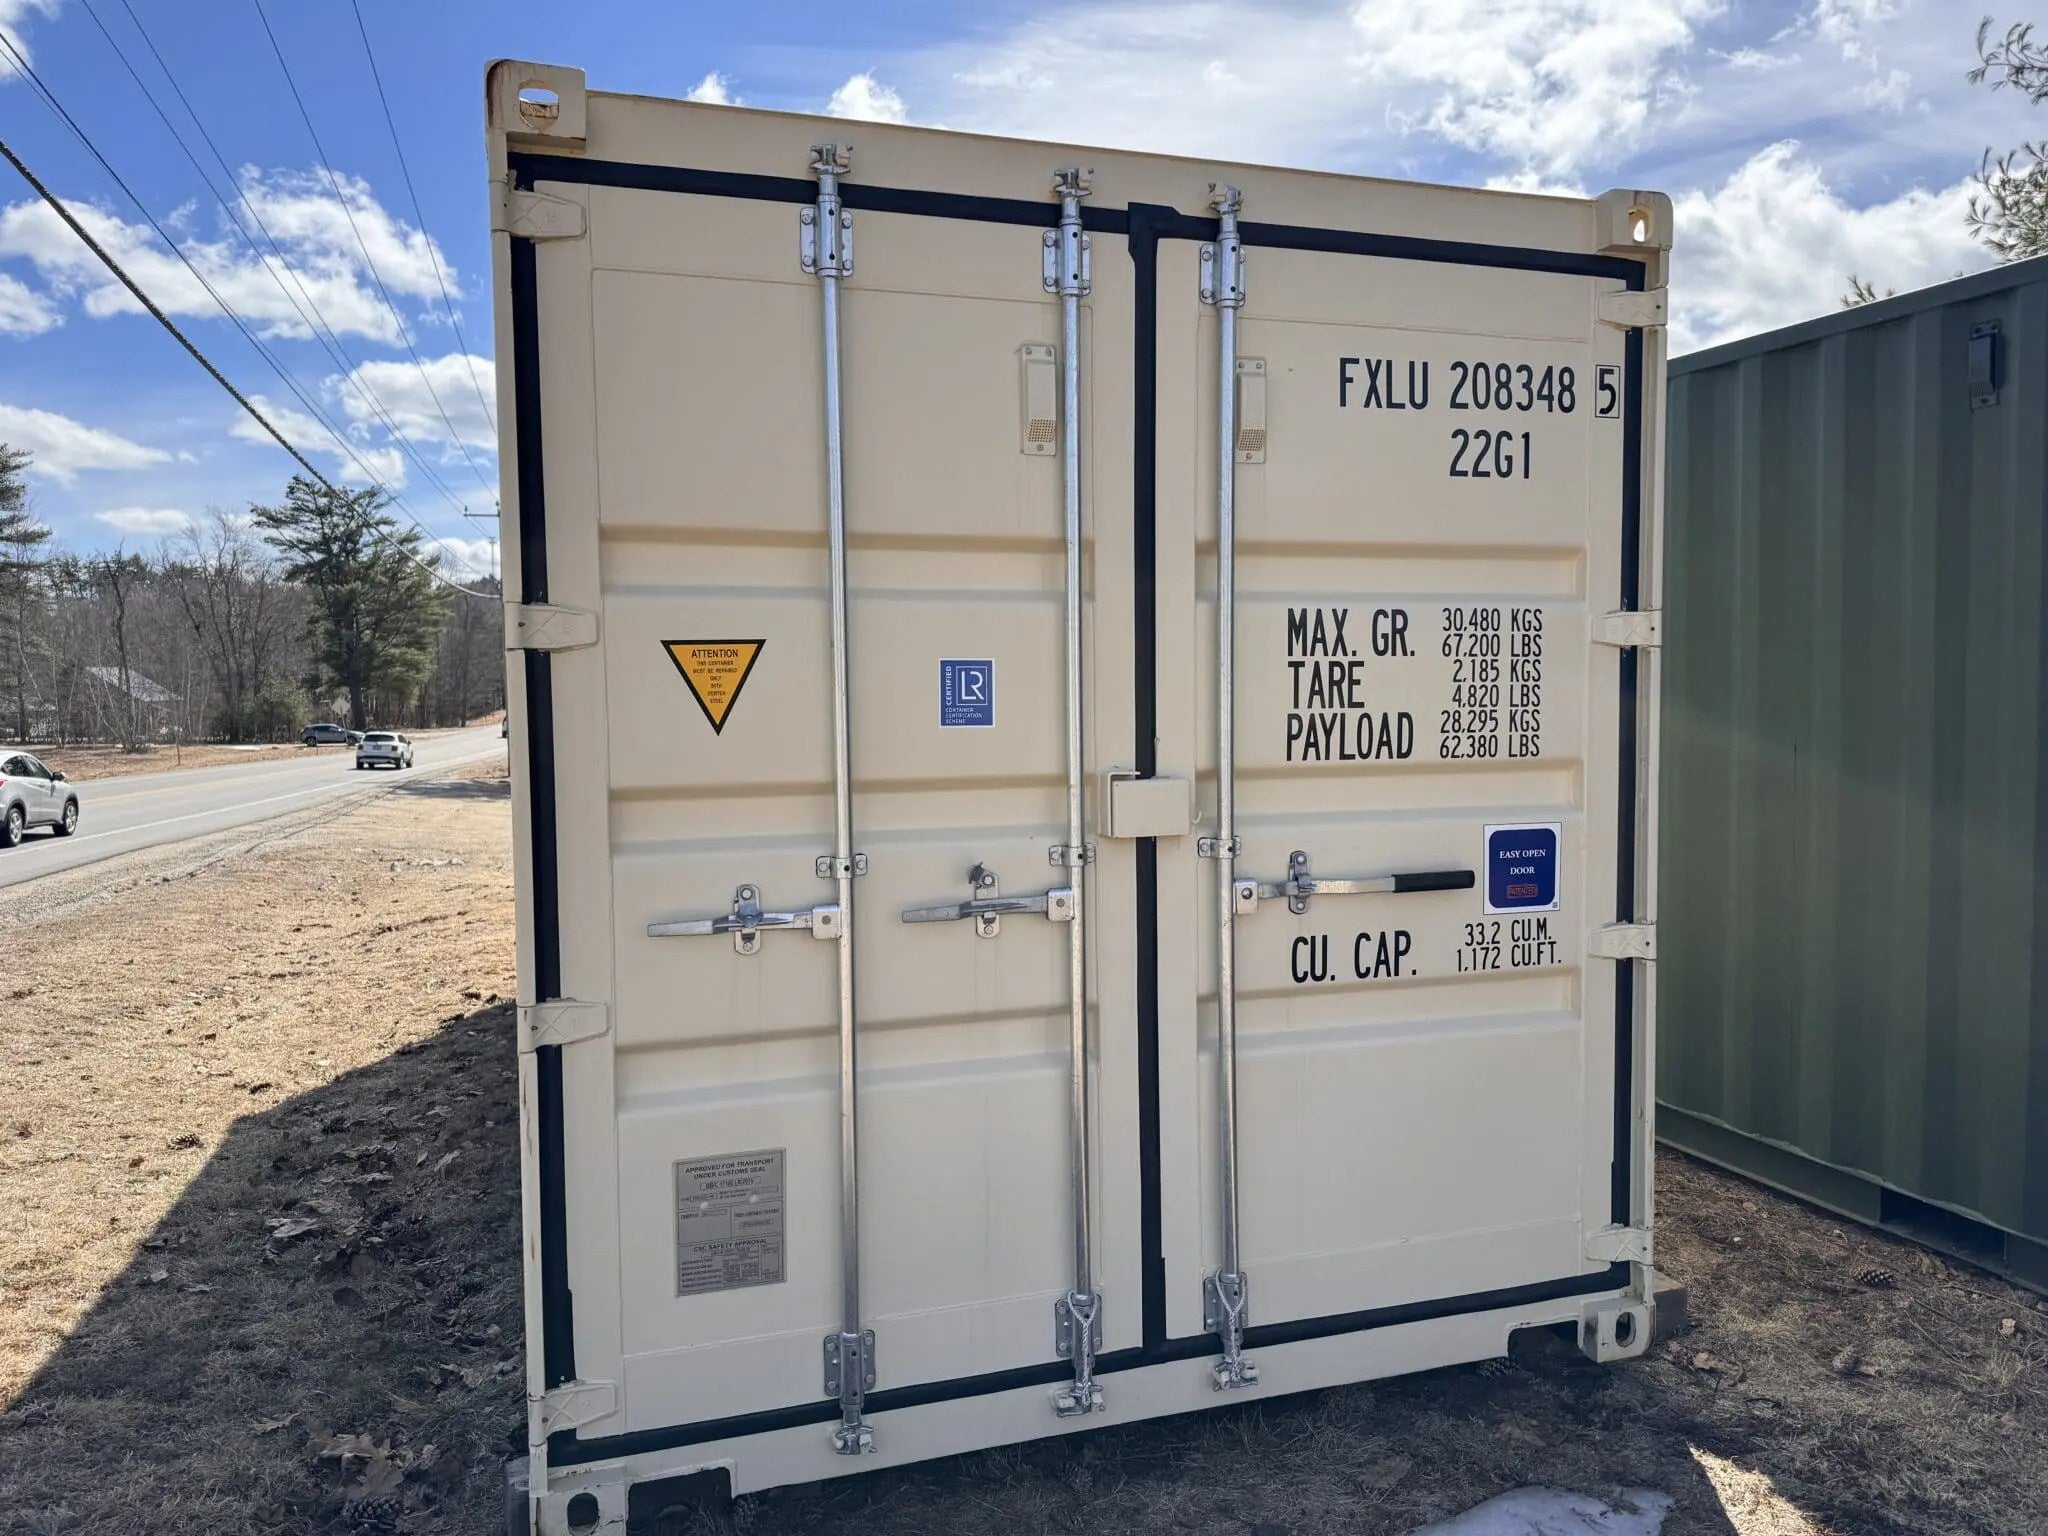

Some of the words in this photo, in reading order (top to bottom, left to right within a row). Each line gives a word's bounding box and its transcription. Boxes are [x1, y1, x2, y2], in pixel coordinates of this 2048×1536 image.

[1339, 358, 1429, 410] FXLU
[1449, 361, 1576, 413] 208348
[1598, 368, 1617, 415] 5
[1449, 428, 1531, 479] 22G1
[1287, 608, 1357, 656] MAX.
[1372, 609, 1415, 656] GR.
[1442, 608, 1501, 632] 30,480
[1511, 609, 1543, 632] KGS
[692, 650, 738, 658] ATTENTION
[1442, 633, 1500, 658] 67,200
[1511, 634, 1542, 658] LBS
[1287, 661, 1364, 709] TARE
[1453, 659, 1499, 683] 2,185
[1510, 659, 1541, 682] KGS
[961, 671, 984, 700] LR
[1452, 684, 1499, 708] 4,820
[1509, 685, 1541, 708] LBS
[1440, 710, 1498, 734] 28,295
[1509, 710, 1540, 733] KGS
[1287, 712, 1414, 761] PAYLOAD
[1440, 735, 1498, 759] 62,380
[1509, 735, 1540, 758] LBS
[1499, 850, 1521, 859] EASY
[1522, 849, 1546, 857] OPEN
[1464, 922, 1500, 946] 33.2
[1511, 918, 1552, 942] CU.M.
[1292, 934, 1335, 983] CU.
[1354, 930, 1417, 979] CAP.
[1457, 947, 1500, 972] 1,172
[1511, 941, 1562, 968] CU.FT.
